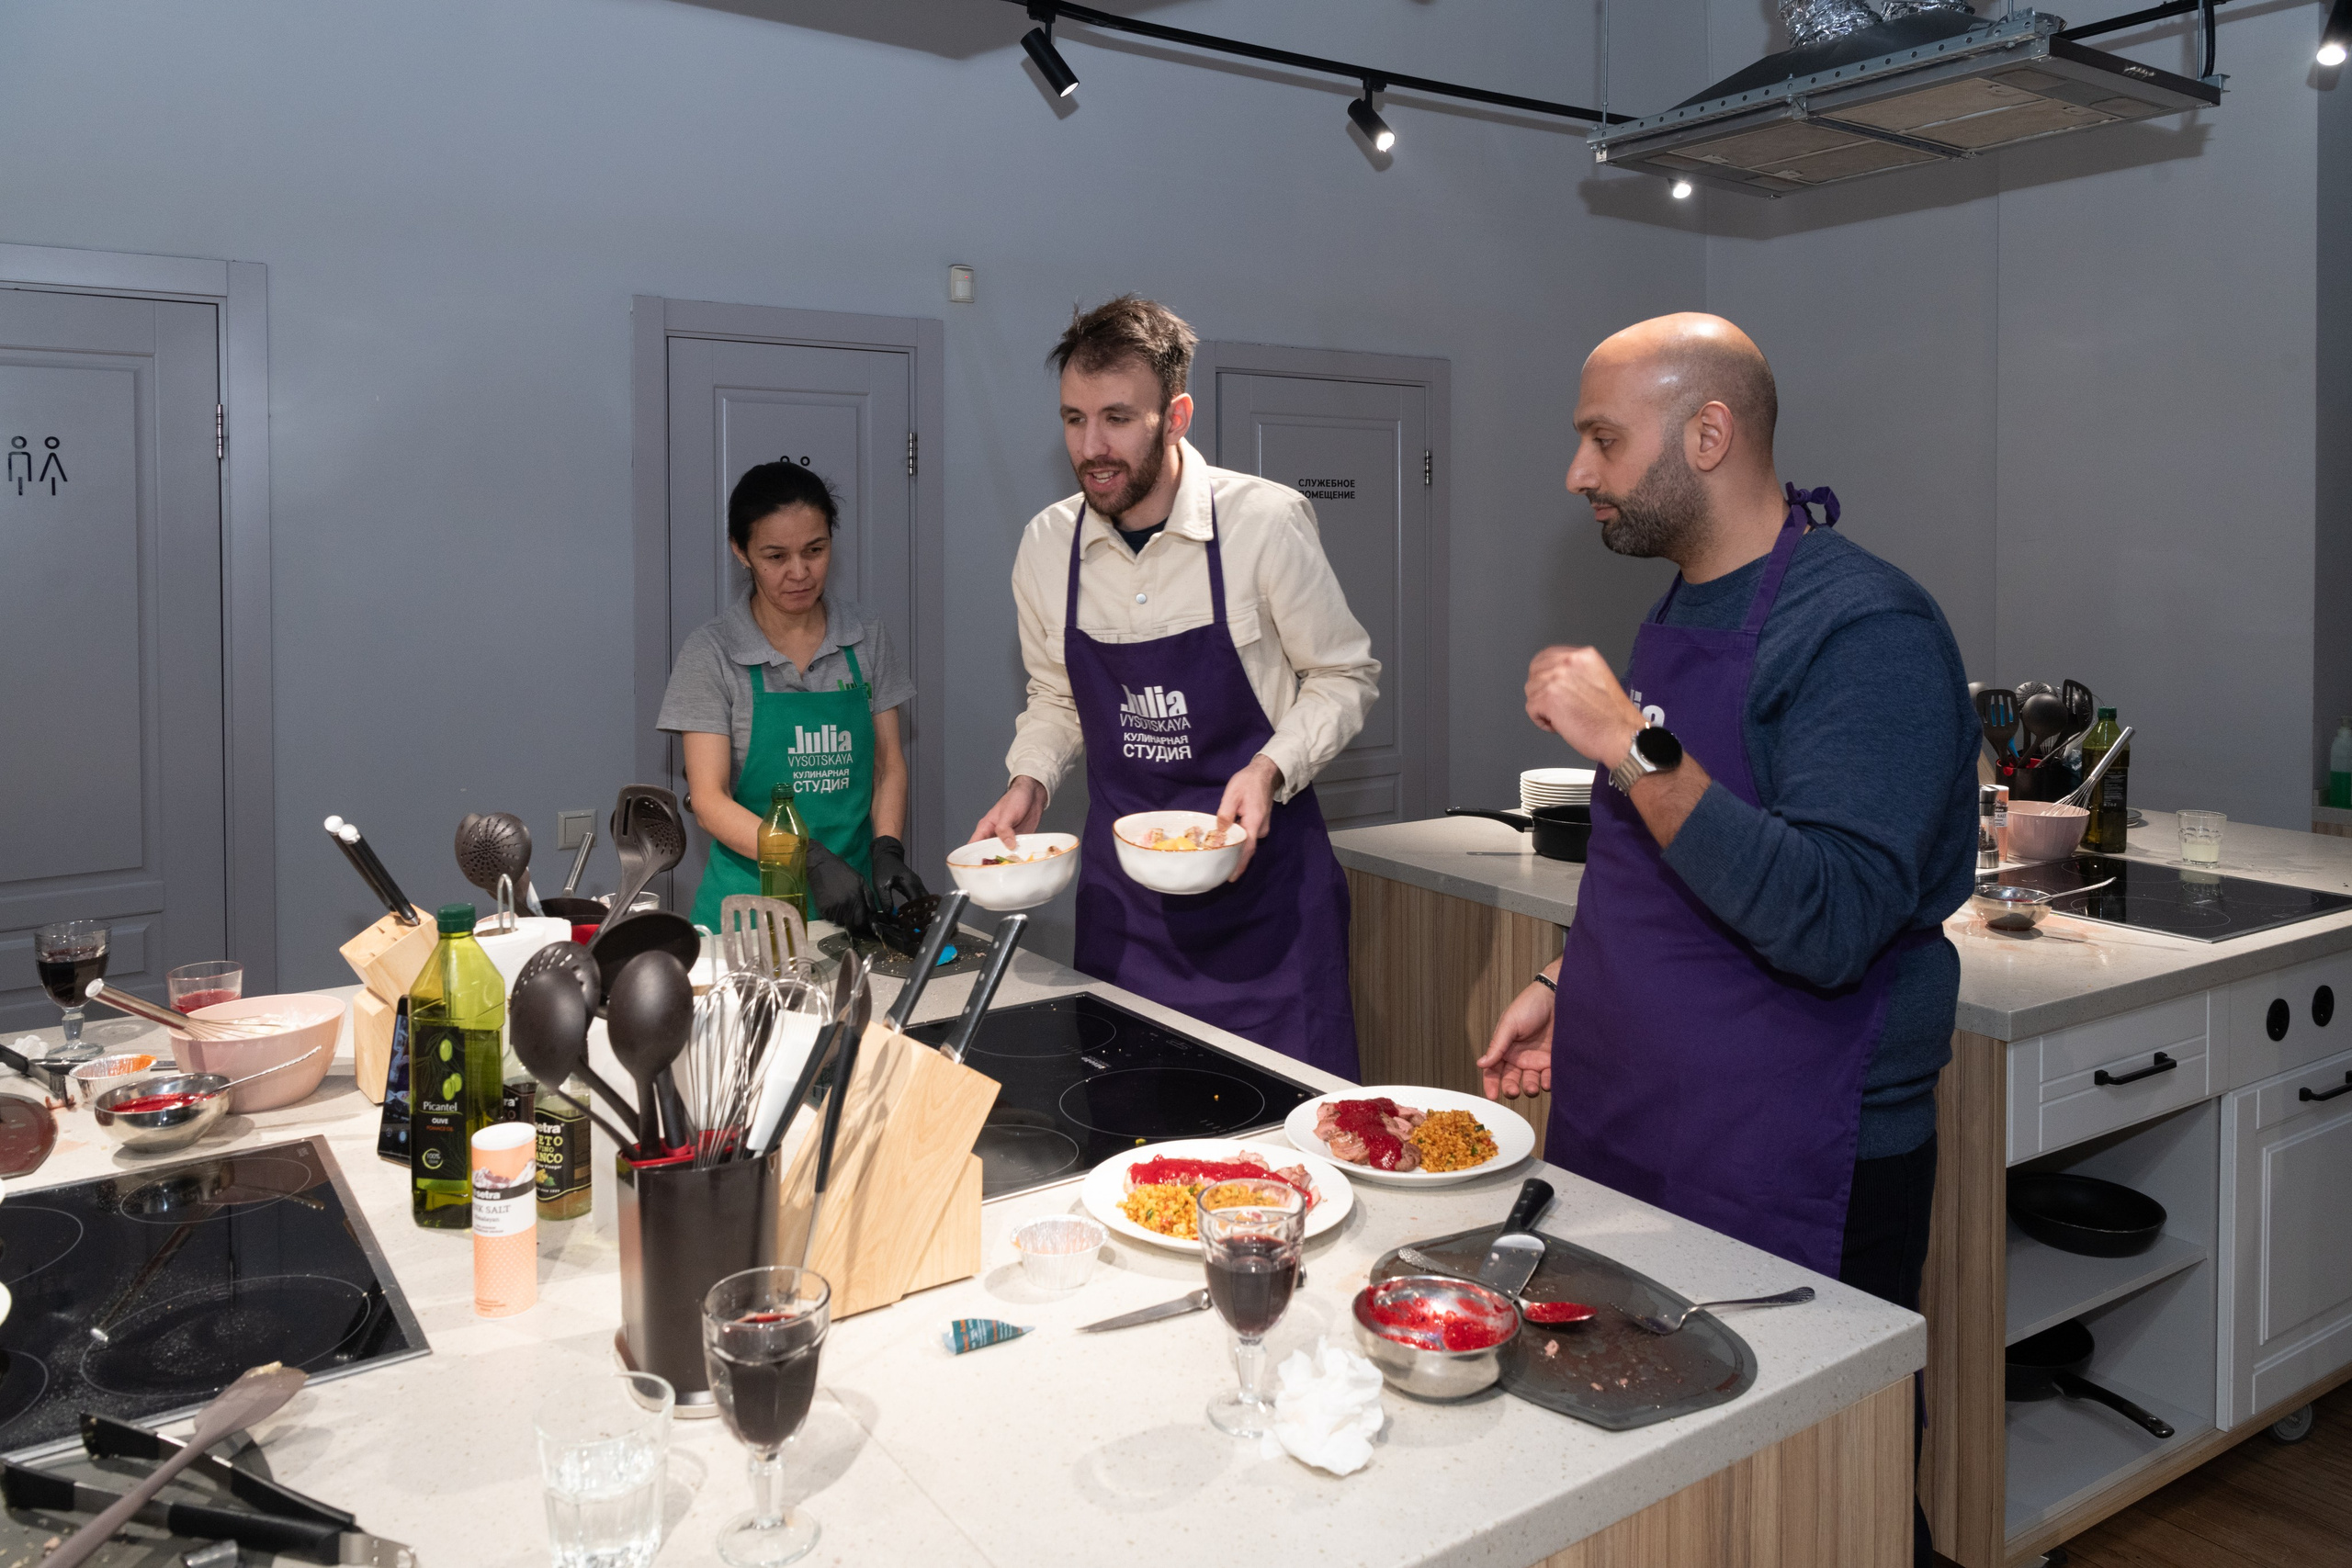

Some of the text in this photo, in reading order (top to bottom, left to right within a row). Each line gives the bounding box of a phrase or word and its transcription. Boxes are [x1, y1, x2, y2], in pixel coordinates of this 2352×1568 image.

[1298, 479, 1355, 488] СЛУЖЕБНОЕ
[1120, 683, 1188, 719] Julia
[1119, 713, 1192, 732] VYSOTSKAYA
[787, 724, 853, 755] Julia
[1123, 732, 1189, 746] КУЛИНАРНАЯ
[1123, 744, 1193, 762] СТУДИЯ
[787, 753, 854, 768] VYSOTSKAYA
[792, 768, 850, 779] КУЛИНАРНАЯ
[793, 777, 850, 795] СТУДИЯ
[423, 1101, 458, 1112] Picantel
[536, 1134, 564, 1147] ETO
[536, 1151, 564, 1165] ANCO
[485, 1204, 511, 1214] SALT
